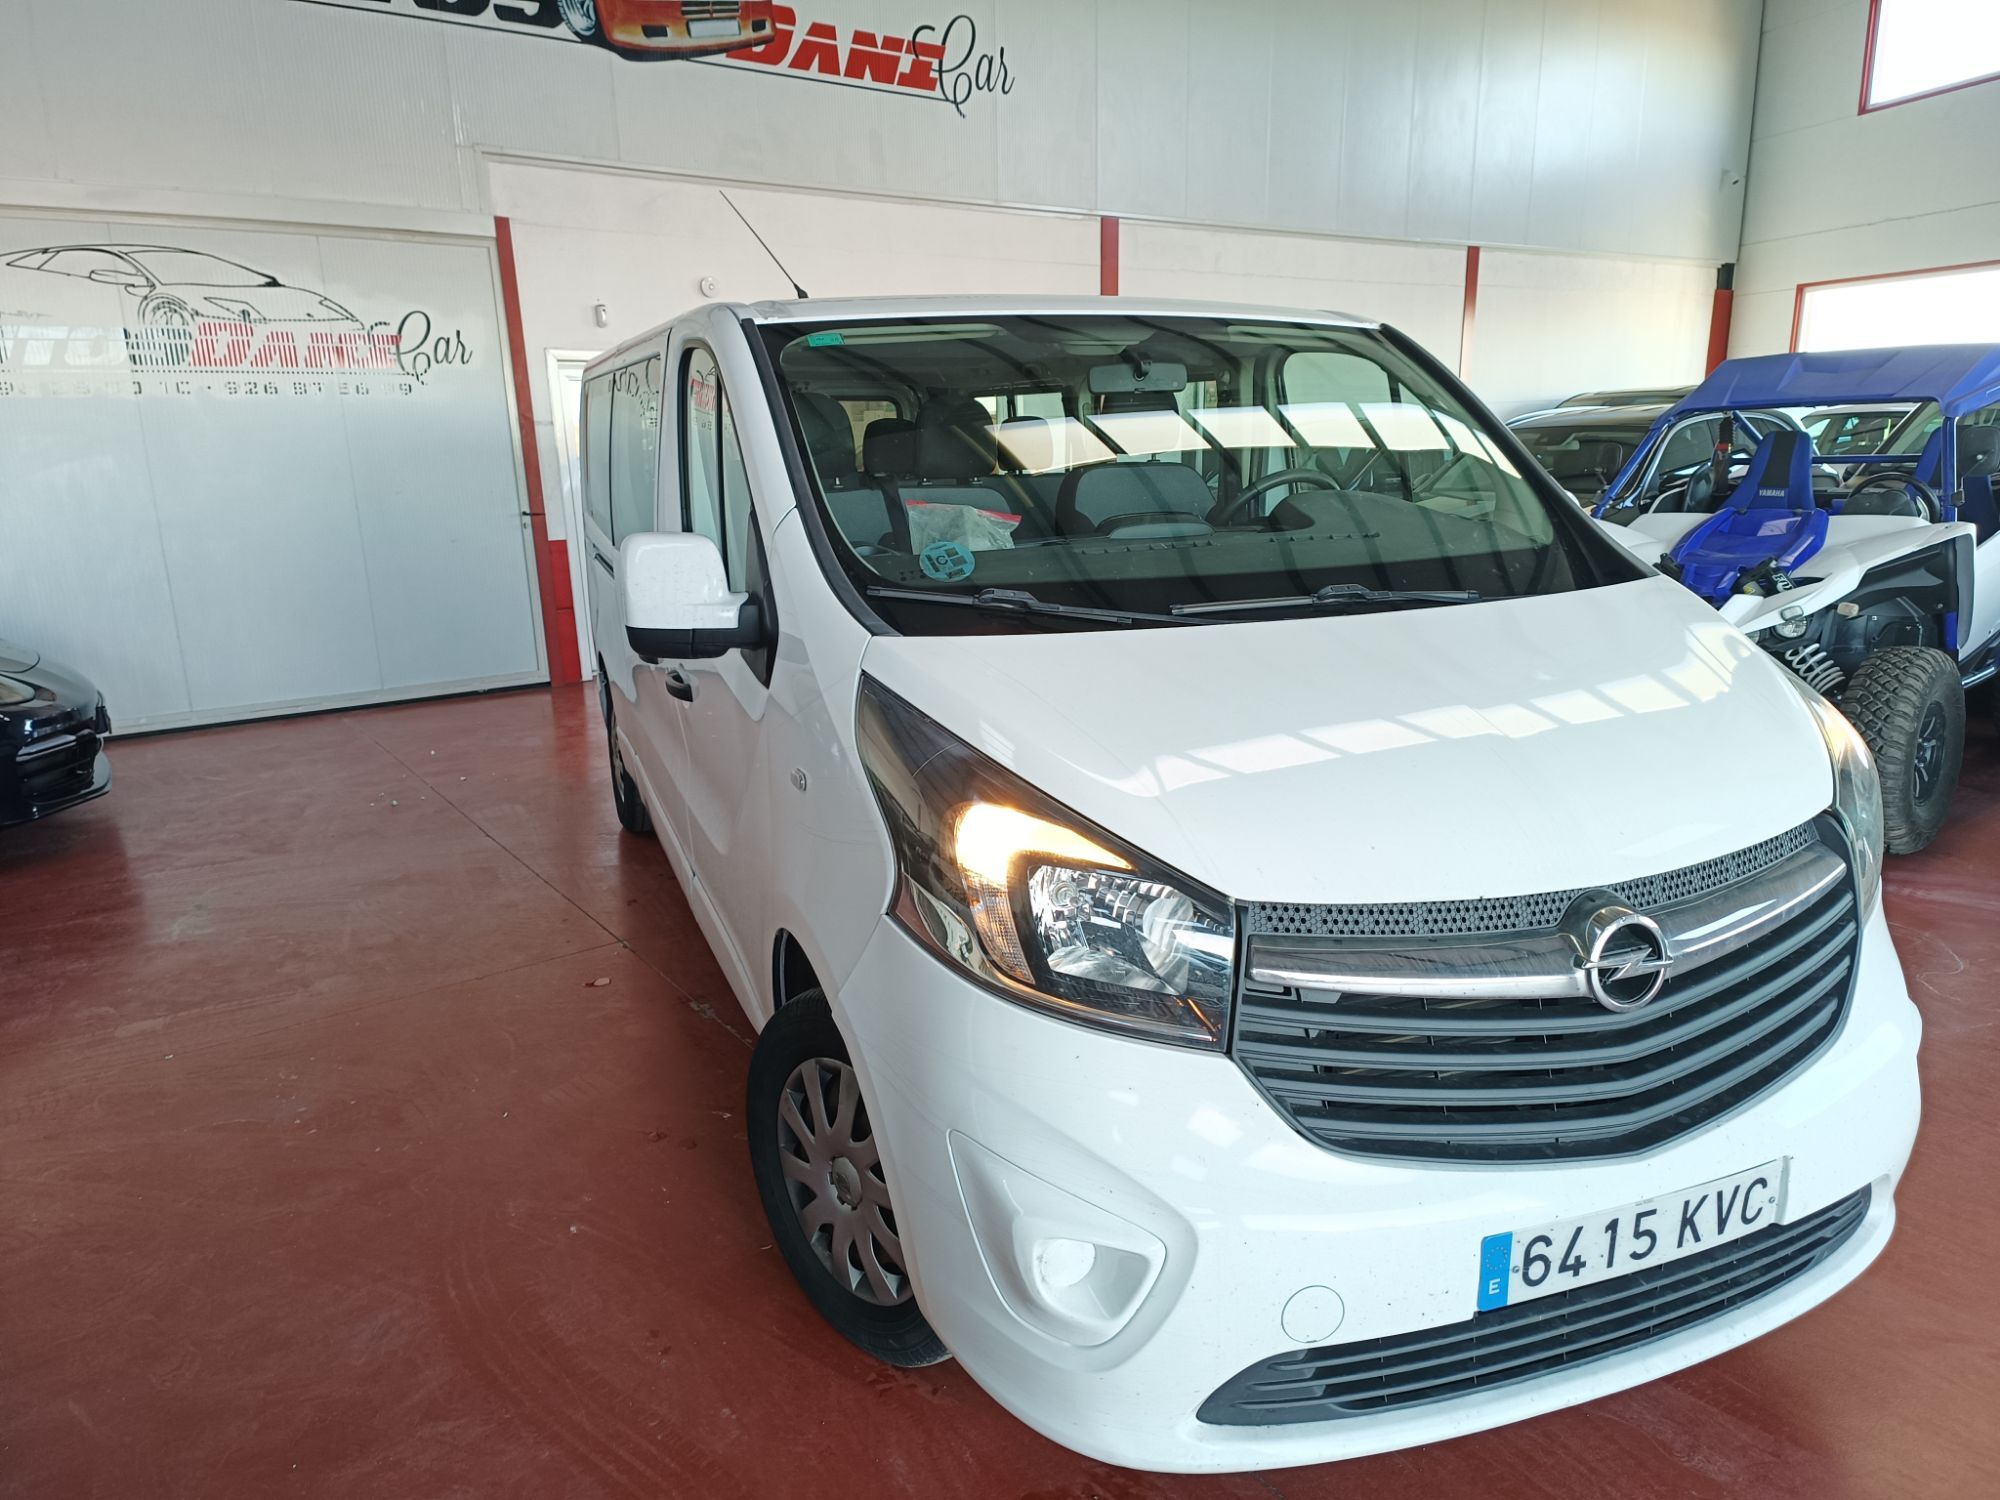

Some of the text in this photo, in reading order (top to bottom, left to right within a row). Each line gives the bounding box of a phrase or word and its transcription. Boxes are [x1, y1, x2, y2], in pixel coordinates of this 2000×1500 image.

[912, 14, 1016, 118] Car
[367, 310, 473, 386] Car
[1758, 488, 1785, 497] YAMAHA
[1521, 1177, 1768, 1287] 6415 KVC
[1487, 1280, 1501, 1295] E
